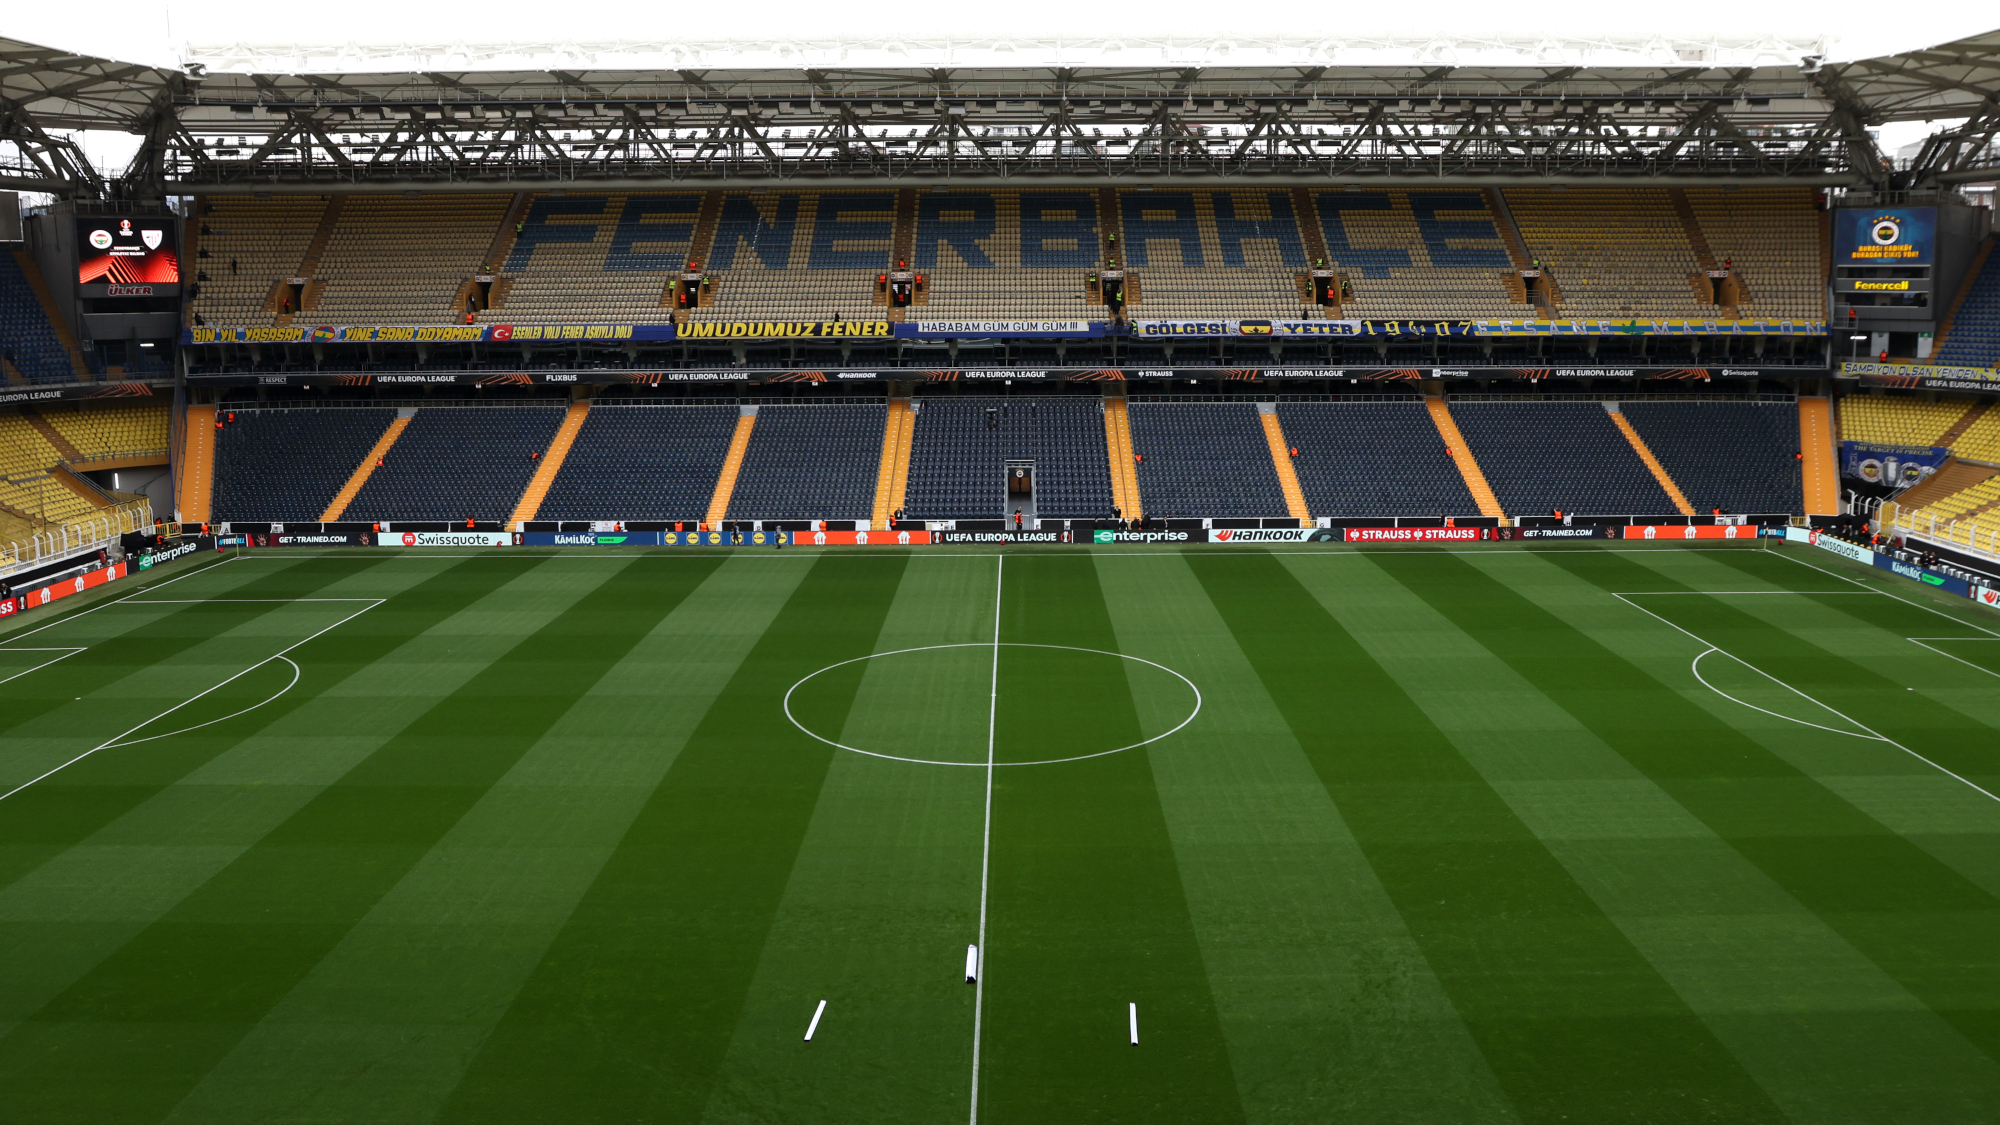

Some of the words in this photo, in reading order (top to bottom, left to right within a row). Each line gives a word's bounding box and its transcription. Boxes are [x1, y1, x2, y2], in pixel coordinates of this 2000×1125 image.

[504, 193, 1512, 278] FENERBAHÇE
[108, 284, 153, 296] ÜLKER
[1854, 280, 1909, 290] Fenercell
[510, 326, 543, 340] ESENLER
[543, 326, 560, 339] YOLU
[560, 326, 584, 339] FENER
[614, 325, 634, 338] DOLU
[676, 322, 816, 338] UMUDUMUZ
[820, 322, 889, 336] FENER
[922, 322, 980, 332] HABABAM
[983, 321, 1009, 332] GÜM
[1012, 321, 1038, 332] GÜM
[1042, 321, 1068, 332] GÜM
[1145, 320, 1228, 335] GÖLGESİ
[1283, 322, 1354, 335] YETER
[244, 328, 304, 343] YAŞASAM
[376, 326, 414, 341] SANA
[1898, 366, 1934, 376] OLSAN
[1949, 381, 1981, 390] EUROPA
[30, 390, 62, 400] LEAGUE
[418, 534, 489, 546] Swissquote
[946, 533, 972, 542] UEFA
[975, 533, 1016, 542] EUROPA
[1017, 532, 1057, 541] LEAGUE
[1100, 530, 1188, 542] enterprise
[1362, 530, 1411, 539] STRAUSS
[1425, 529, 1475, 539] STRAUSS
[1817, 534, 1859, 559] Swissquote
[140, 542, 196, 566] enterprise
